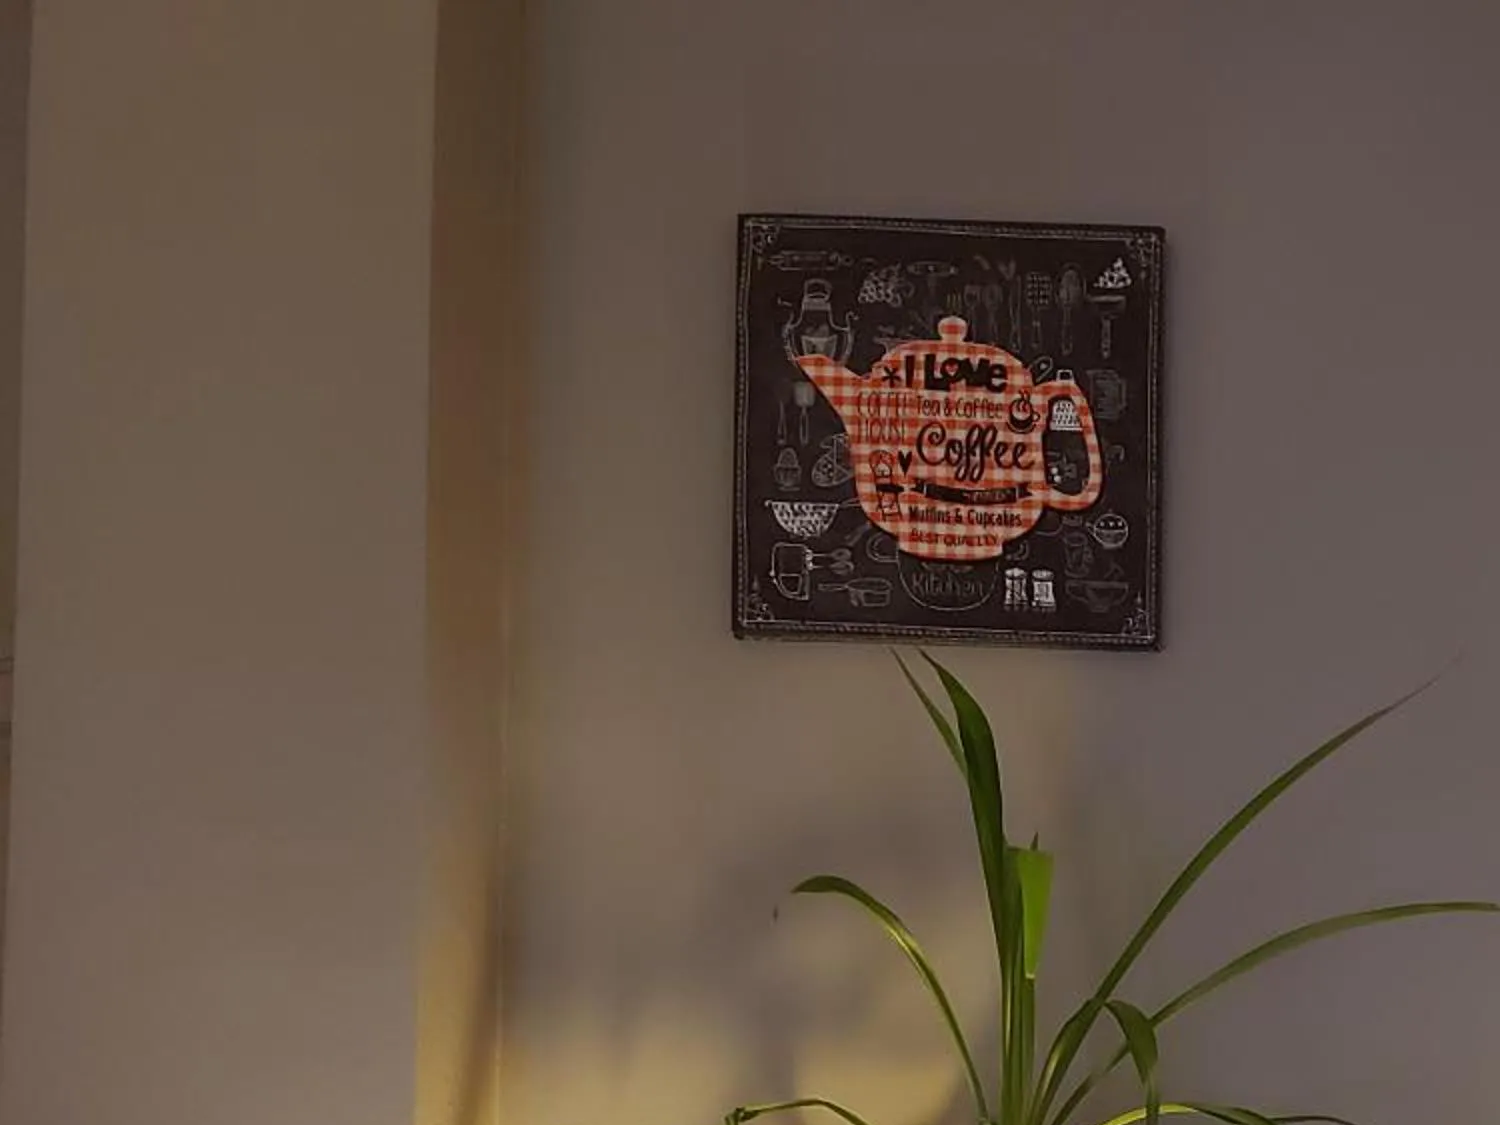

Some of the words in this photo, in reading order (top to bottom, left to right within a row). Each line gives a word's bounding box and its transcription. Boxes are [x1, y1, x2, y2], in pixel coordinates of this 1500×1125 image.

[905, 355, 915, 388] I
[916, 395, 941, 417] Tea
[916, 421, 1035, 482] Coffee
[967, 508, 1023, 528] Cupcakes
